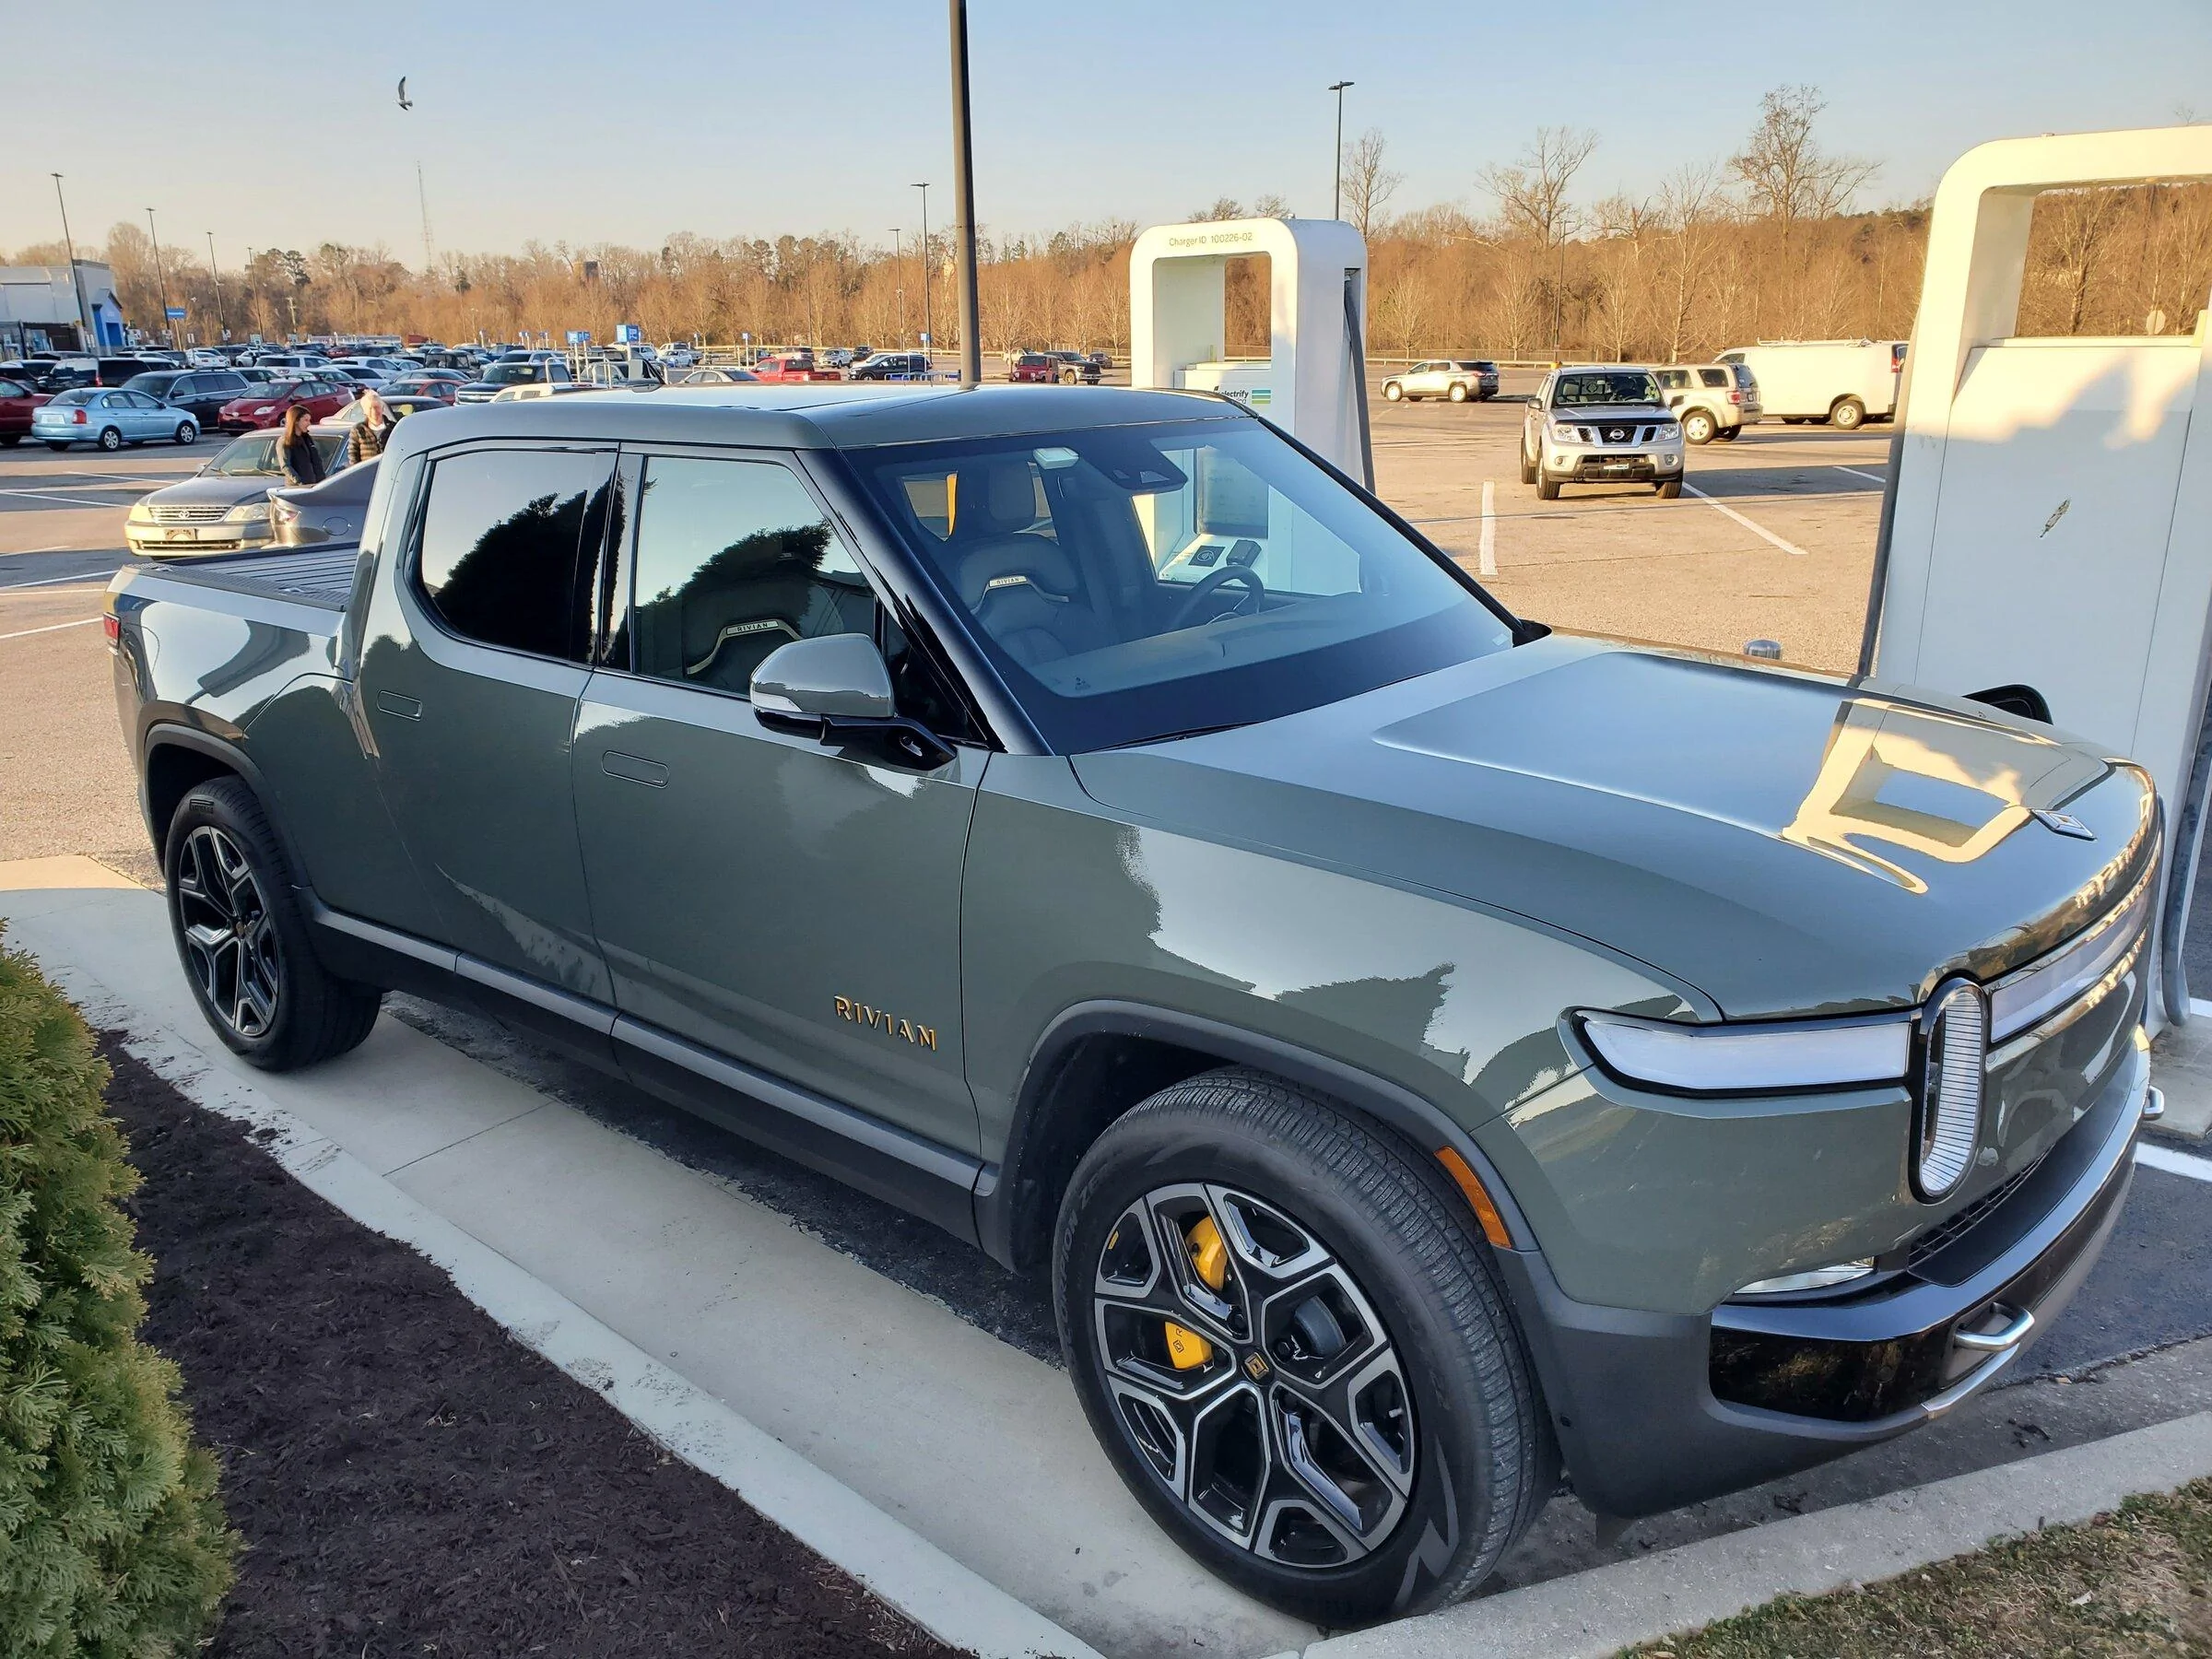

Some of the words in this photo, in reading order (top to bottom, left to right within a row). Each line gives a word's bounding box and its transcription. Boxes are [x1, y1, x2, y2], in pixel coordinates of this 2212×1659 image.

[1169, 237, 1197, 247] Charger
[1198, 235, 1207, 244] ID
[1211, 231, 1253, 244] 100226-02
[737, 622, 769, 632] RIVIAN
[833, 994, 937, 1052] RIVIAN
